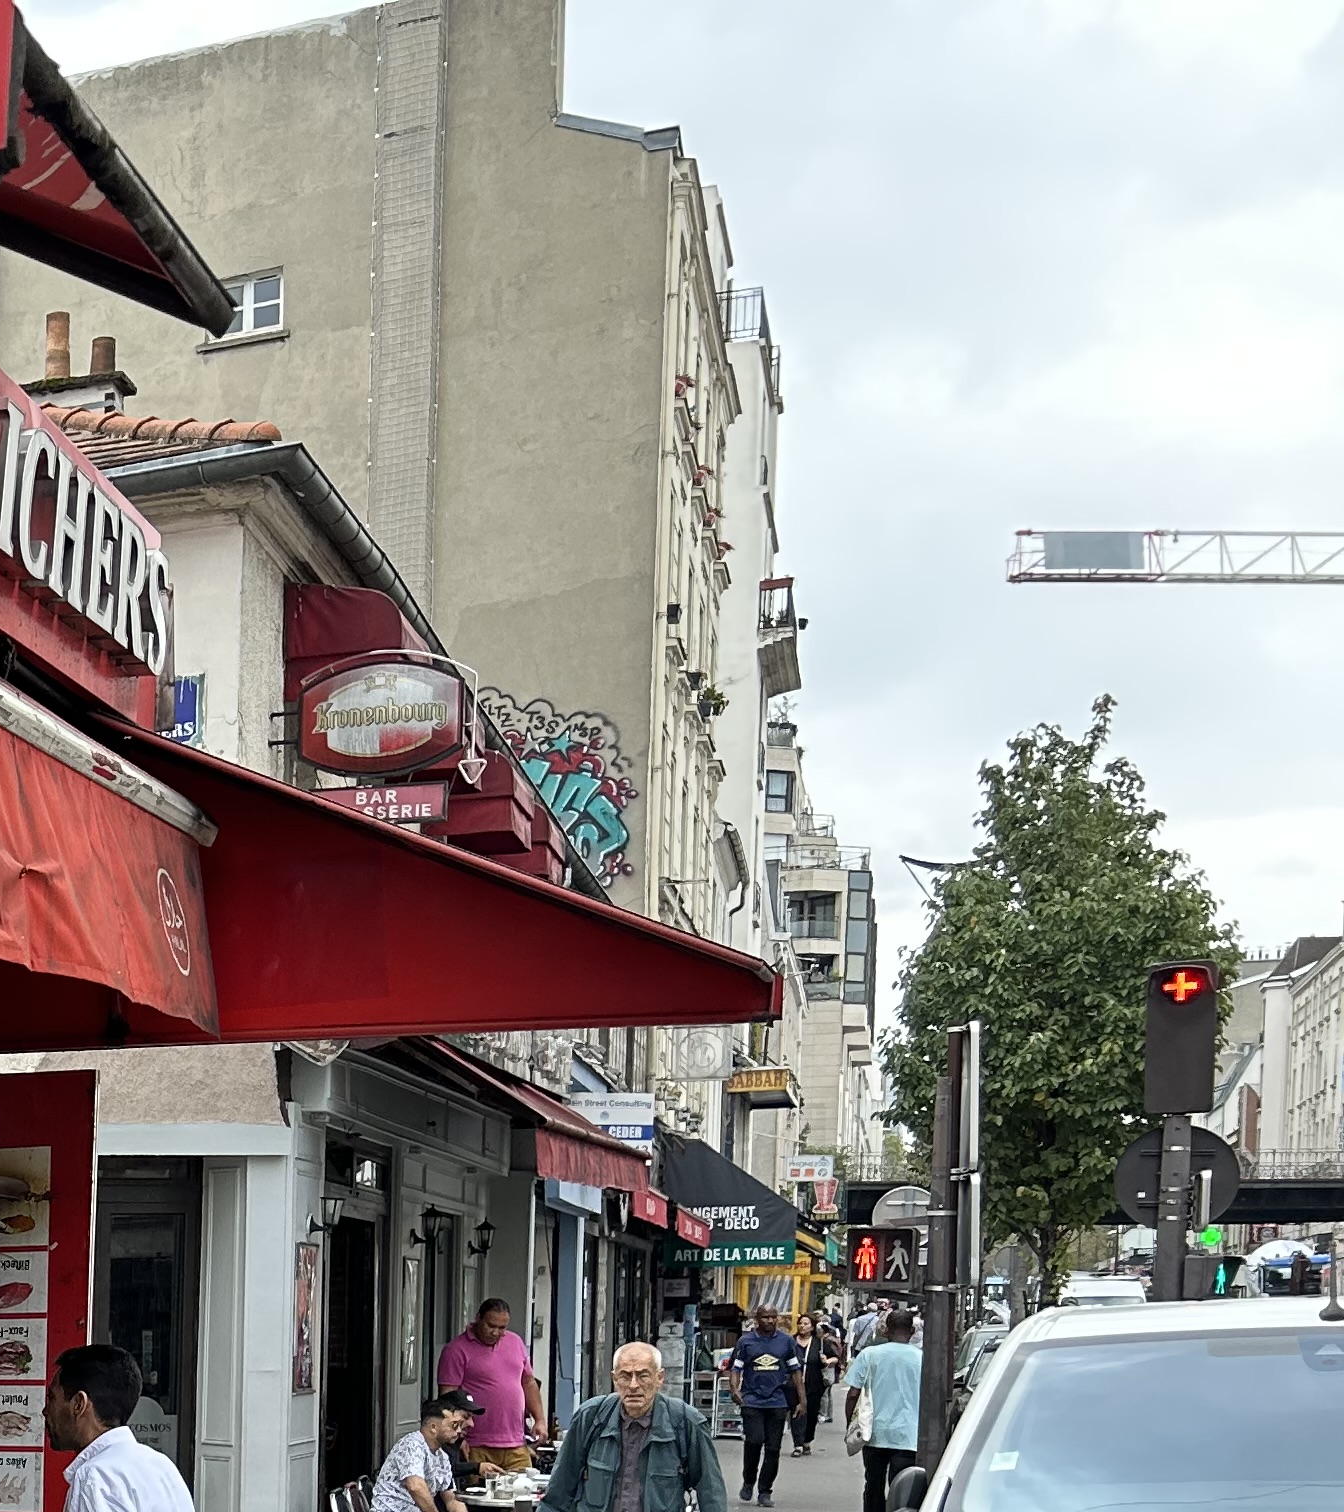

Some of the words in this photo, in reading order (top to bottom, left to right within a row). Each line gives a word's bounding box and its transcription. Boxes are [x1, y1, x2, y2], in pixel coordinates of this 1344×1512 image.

[313, 697, 448, 732] Kronenbourg
[355, 789, 397, 805] BAR
[608, 1125, 643, 1139] CEDER
[724, 1216, 760, 1230] DECO
[674, 1249, 700, 1262] ART
[703, 1248, 721, 1262] DE
[724, 1247, 741, 1261] LA
[743, 1246, 785, 1261] TABLE
